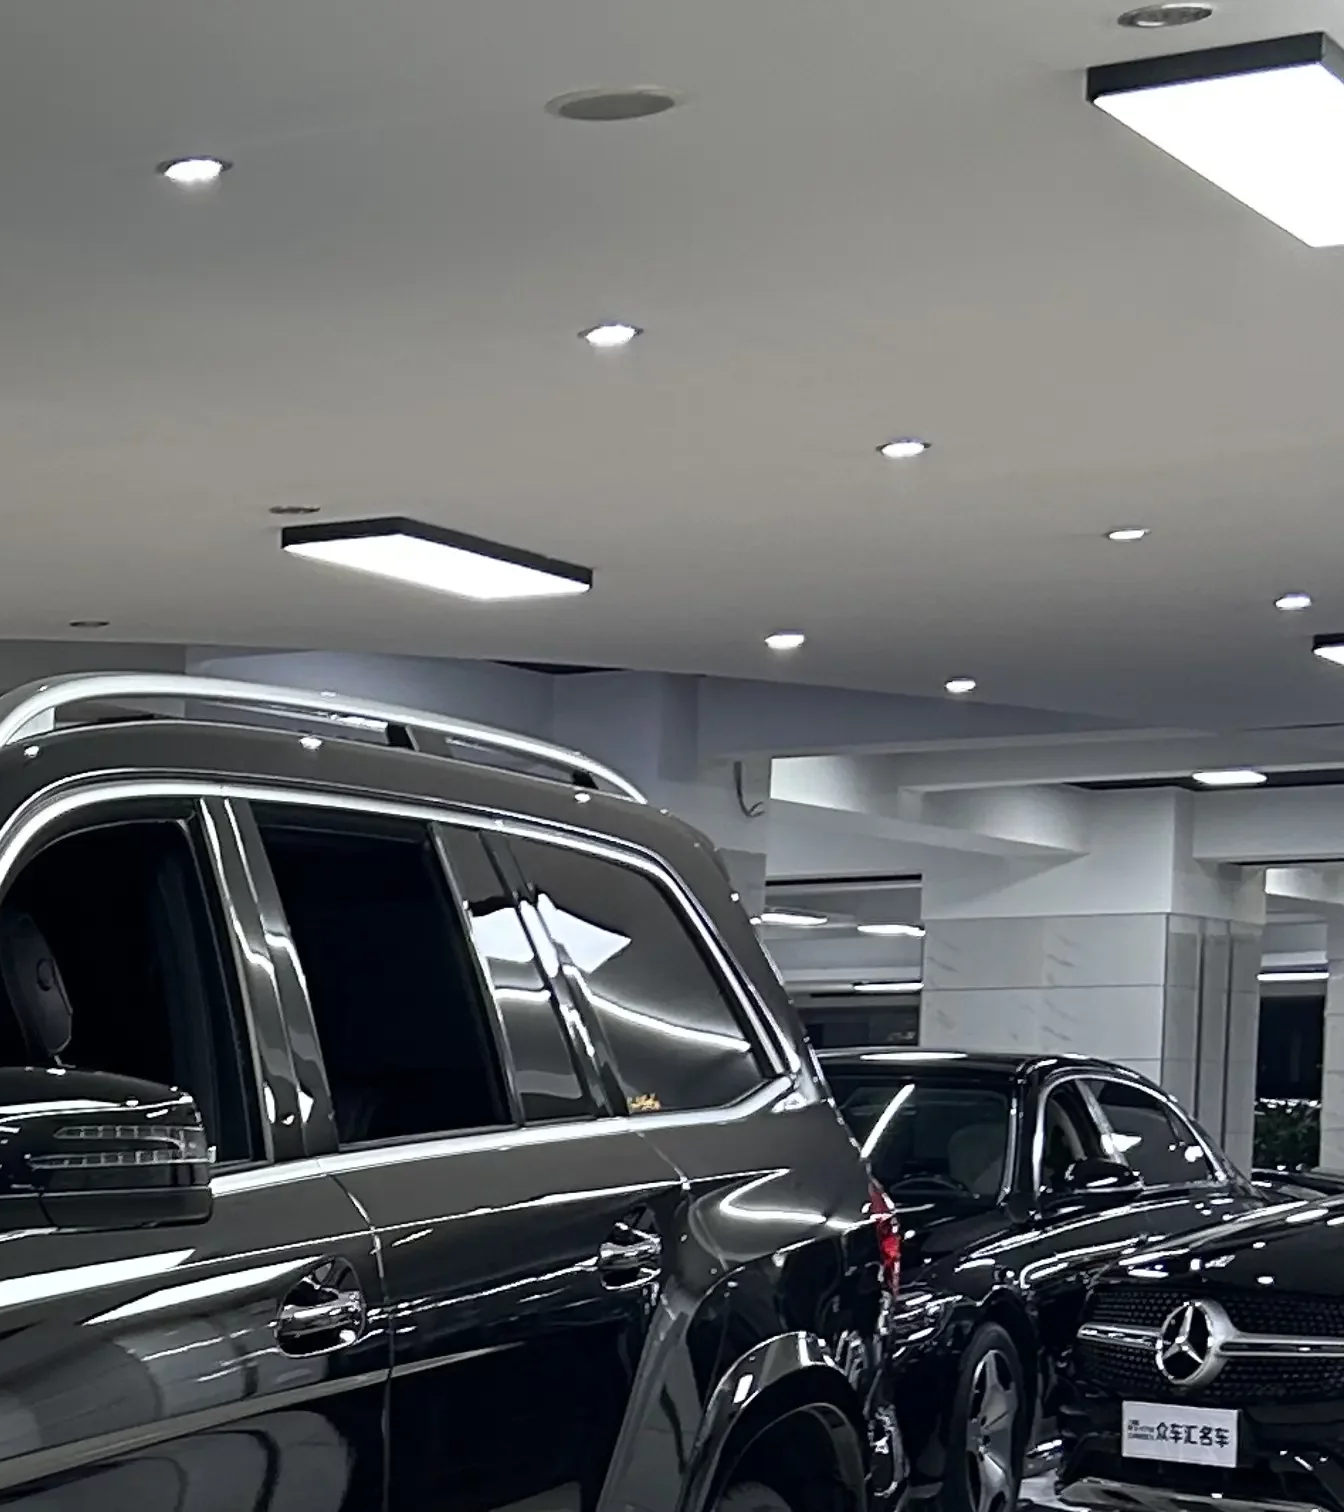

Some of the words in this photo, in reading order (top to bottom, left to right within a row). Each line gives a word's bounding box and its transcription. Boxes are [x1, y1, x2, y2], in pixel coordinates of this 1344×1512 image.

[1156, 1422, 1230, 1448] 众车汇名车
